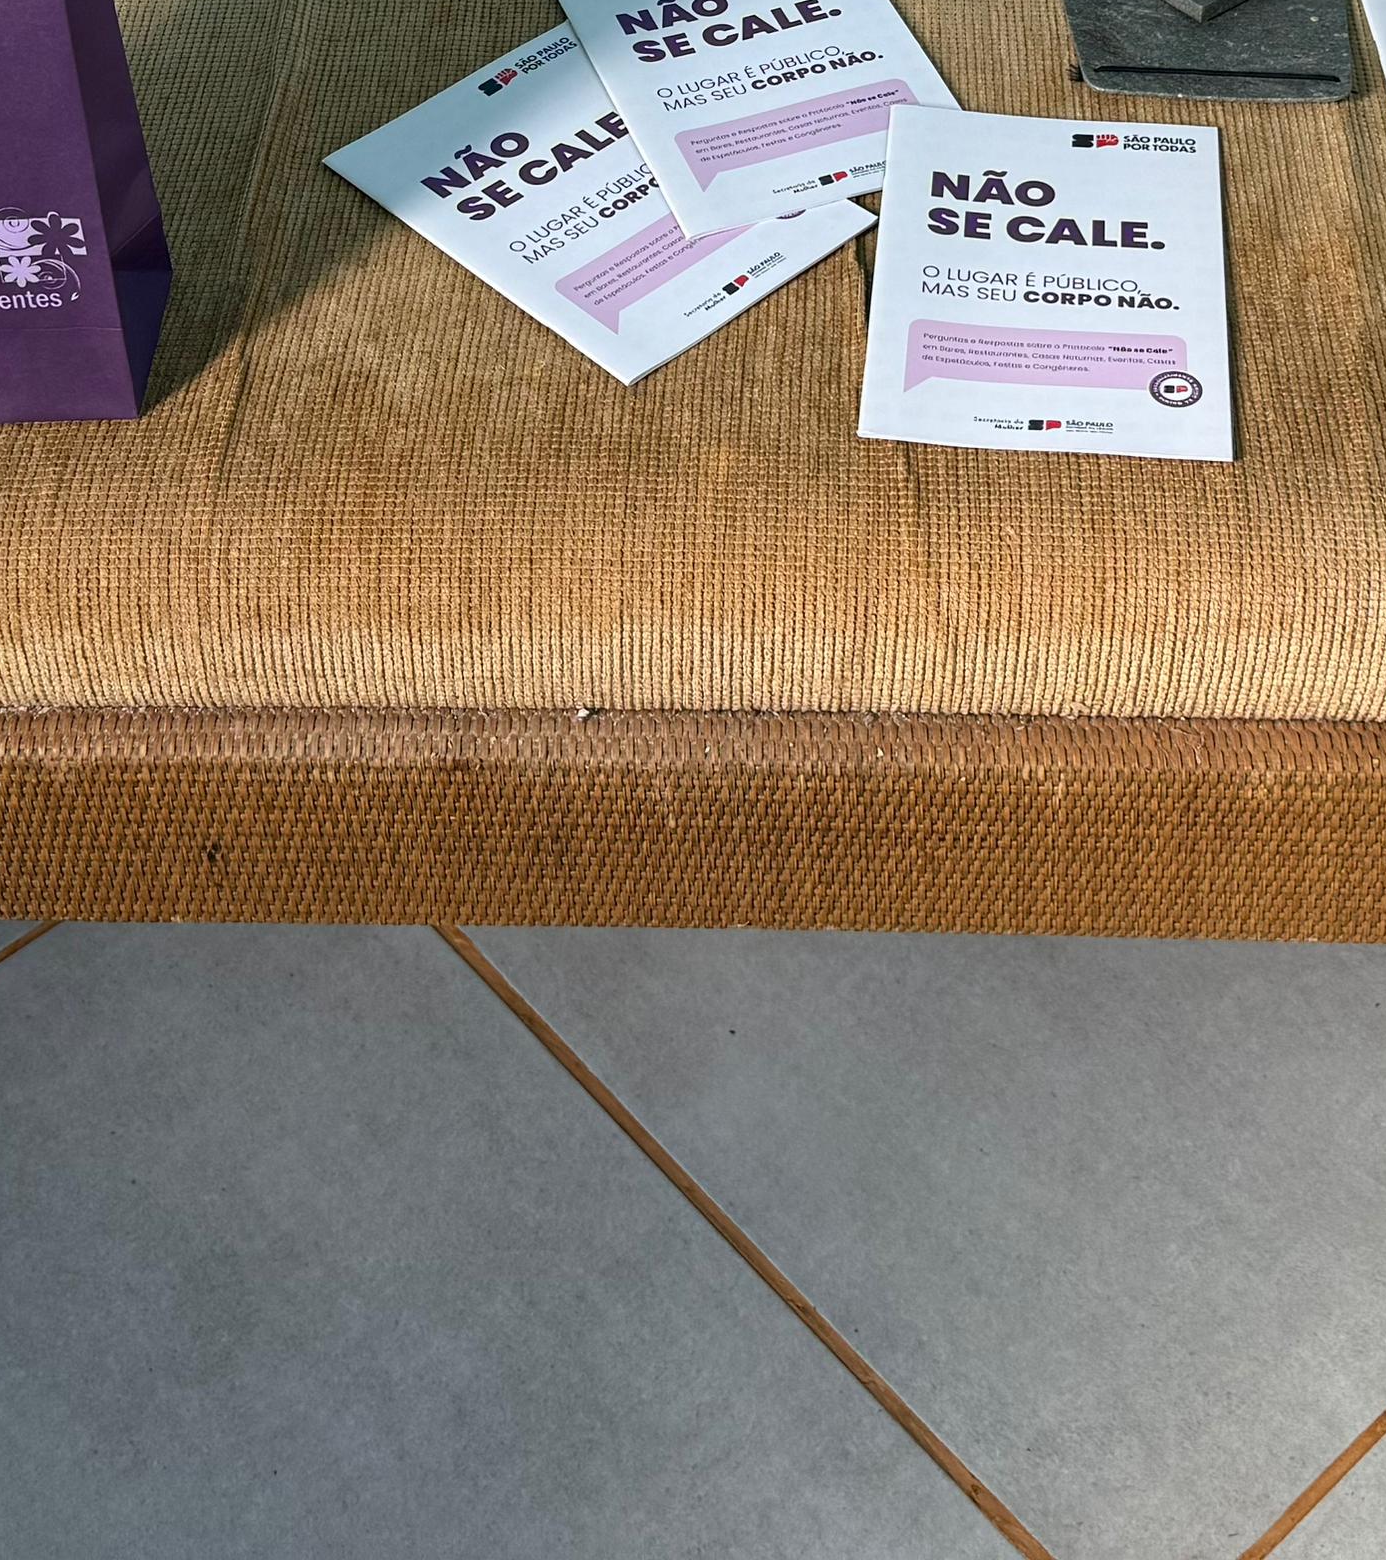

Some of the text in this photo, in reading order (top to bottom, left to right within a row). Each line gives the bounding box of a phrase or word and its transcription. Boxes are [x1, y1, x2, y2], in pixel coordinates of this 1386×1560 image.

[514, 37, 570, 69] SÃO PAULO
[521, 41, 578, 74] POR TODAS
[632, 32, 696, 62] SE
[657, 46, 845, 98] O LUGAR É PÚBLICO,
[663, 51, 883, 111] MAS SEU CORPO NÃO.
[1123, 134, 1196, 146] SÃO PAULO
[1123, 141, 1196, 153] POR TODAS
[420, 132, 529, 198] NÃO
[457, 179, 524, 220] SE
[931, 170, 1055, 207] NÃO
[509, 241, 526, 252] O
[526, 206, 586, 243] LUGAR
[582, 196, 599, 209] É
[522, 238, 565, 264] MAS
[564, 216, 599, 240] SEU
[927, 207, 1165, 250] SE CALE.
[922, 281, 1180, 310] MAS SEU CORPO NÃO.
[923, 265, 1142, 294] O LUGAR É PÚBLICO,
